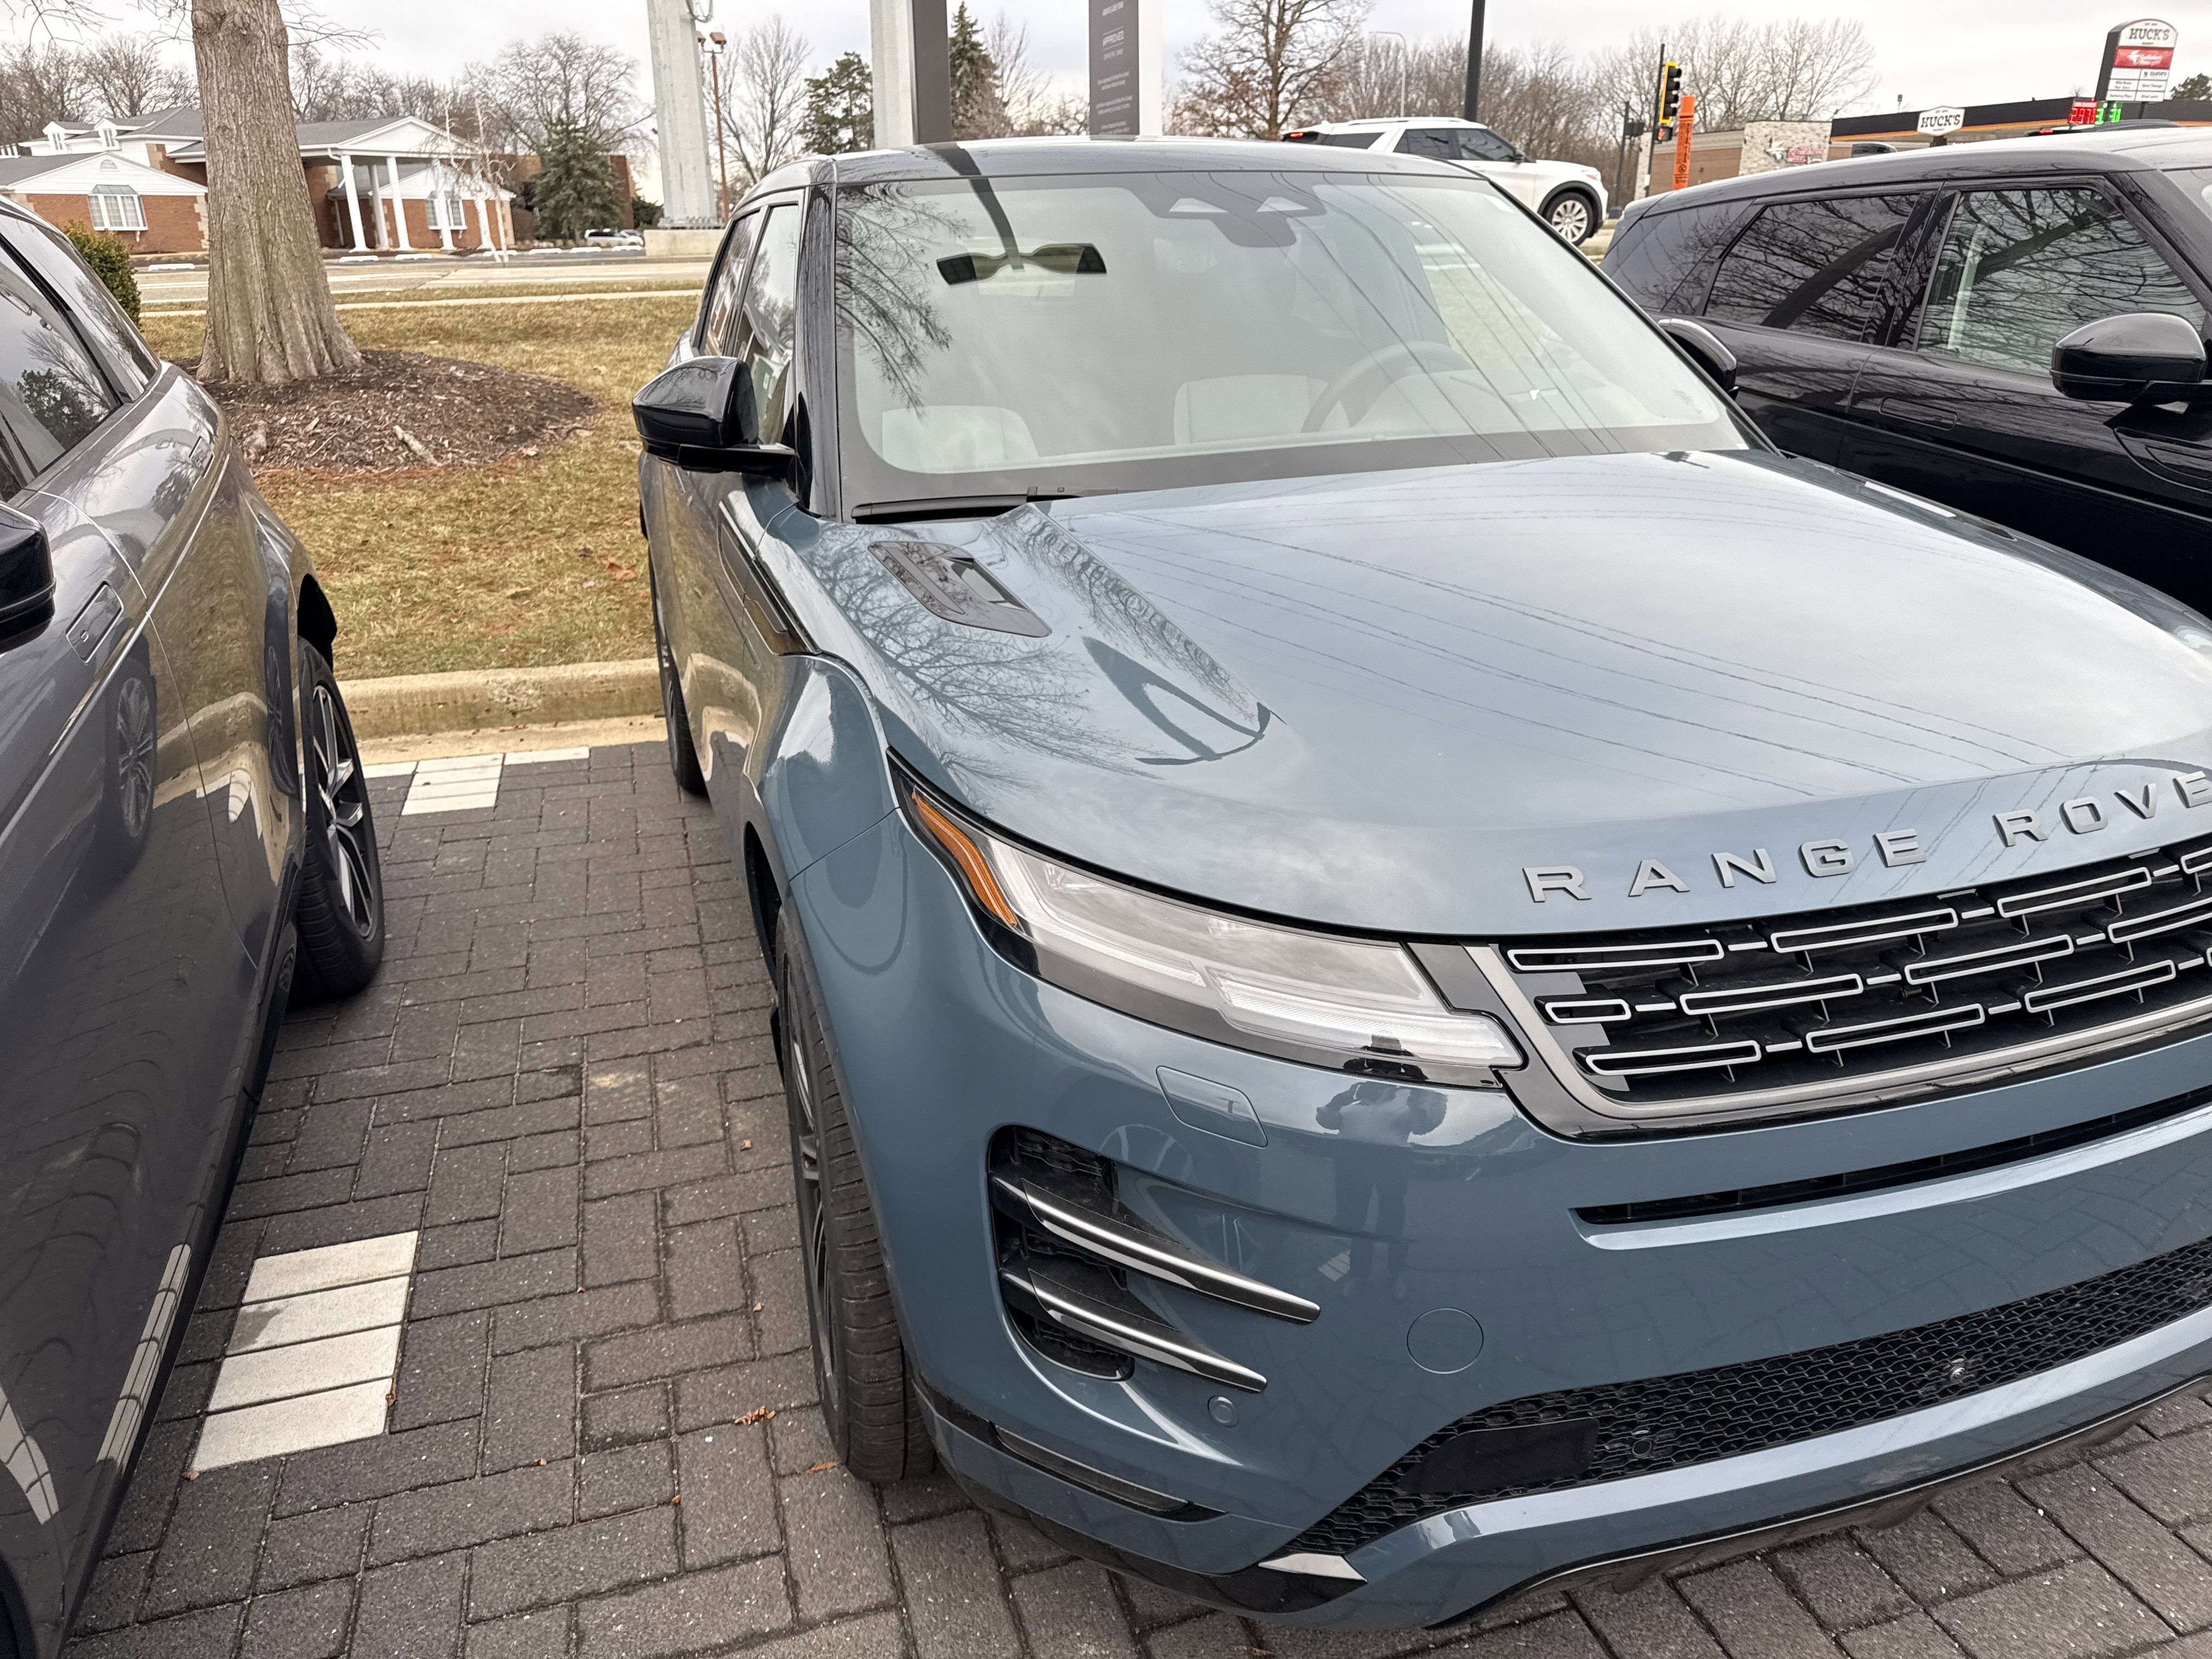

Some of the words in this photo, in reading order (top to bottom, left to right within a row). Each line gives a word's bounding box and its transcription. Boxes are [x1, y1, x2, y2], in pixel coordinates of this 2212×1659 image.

[2129, 28, 2170, 41] HUCK'S
[1920, 114, 1961, 128] HUCK'S
[1523, 828, 1927, 903] RANGE
[1993, 771, 2212, 847] ROVE
